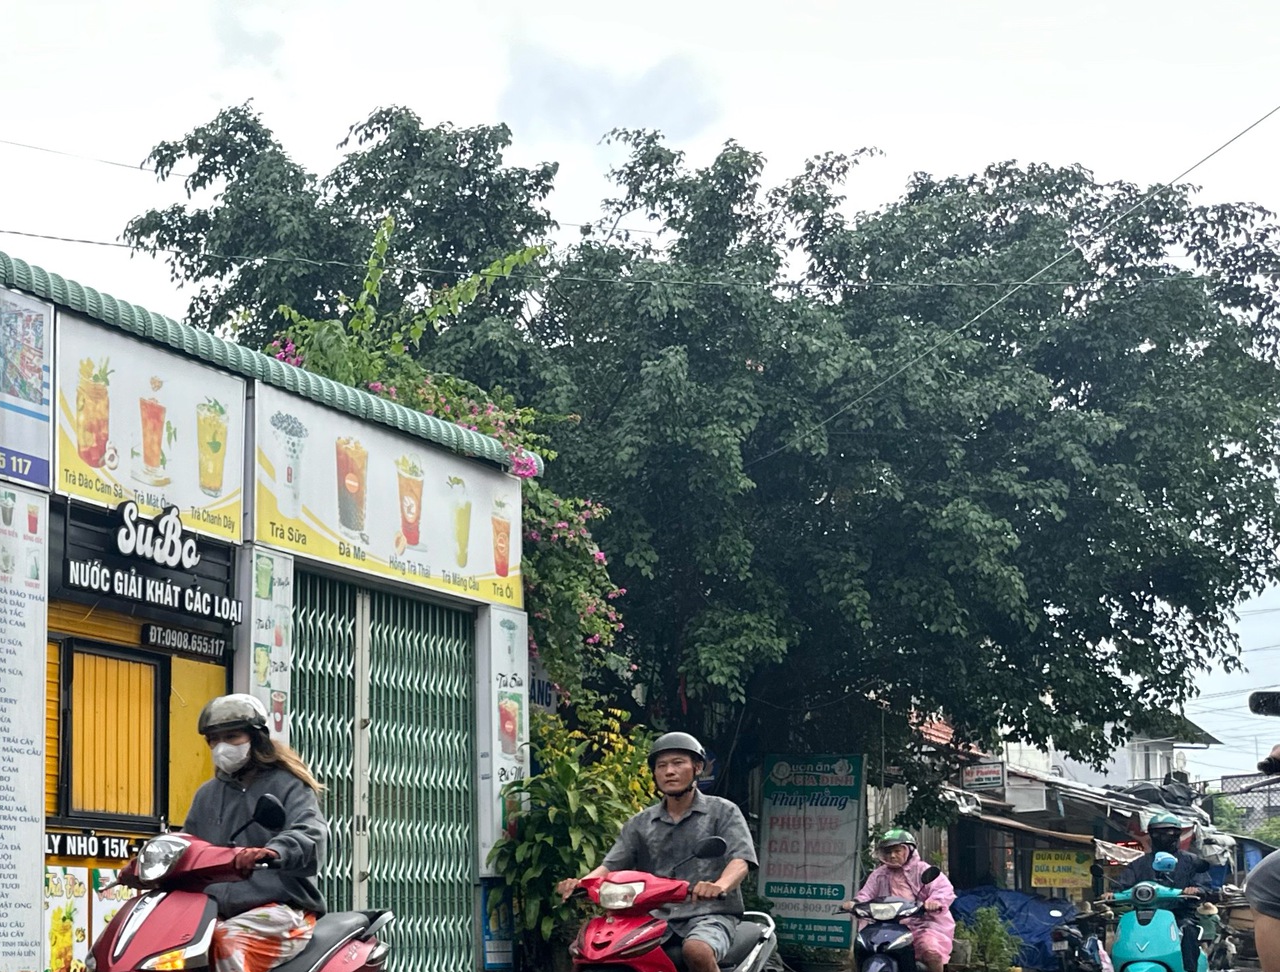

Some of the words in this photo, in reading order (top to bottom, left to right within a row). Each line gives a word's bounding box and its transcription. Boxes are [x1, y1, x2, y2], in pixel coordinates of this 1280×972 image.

[10, 455, 32, 476] 117
[64, 468, 77, 485] Trà
[78, 472, 94, 490] Đào
[95, 478, 112, 496] Cam
[202, 509, 222, 526] Chanh
[117, 502, 201, 569] SuBo
[269, 521, 285, 540] Trà
[287, 527, 307, 546] Sữa
[353, 545, 366, 562] Me
[69, 558, 110, 592] NƯỚC
[113, 568, 143, 599] GIẢI
[146, 579, 182, 608] KHÁT
[184, 584, 212, 615] CÁC
[214, 596, 243, 626] LOẠI
[45, 834, 62, 855] LY
[66, 830, 99, 856] NHỎ
[102, 839, 129, 858] 15K
[775, 902, 843, 913] 0906.809.97
